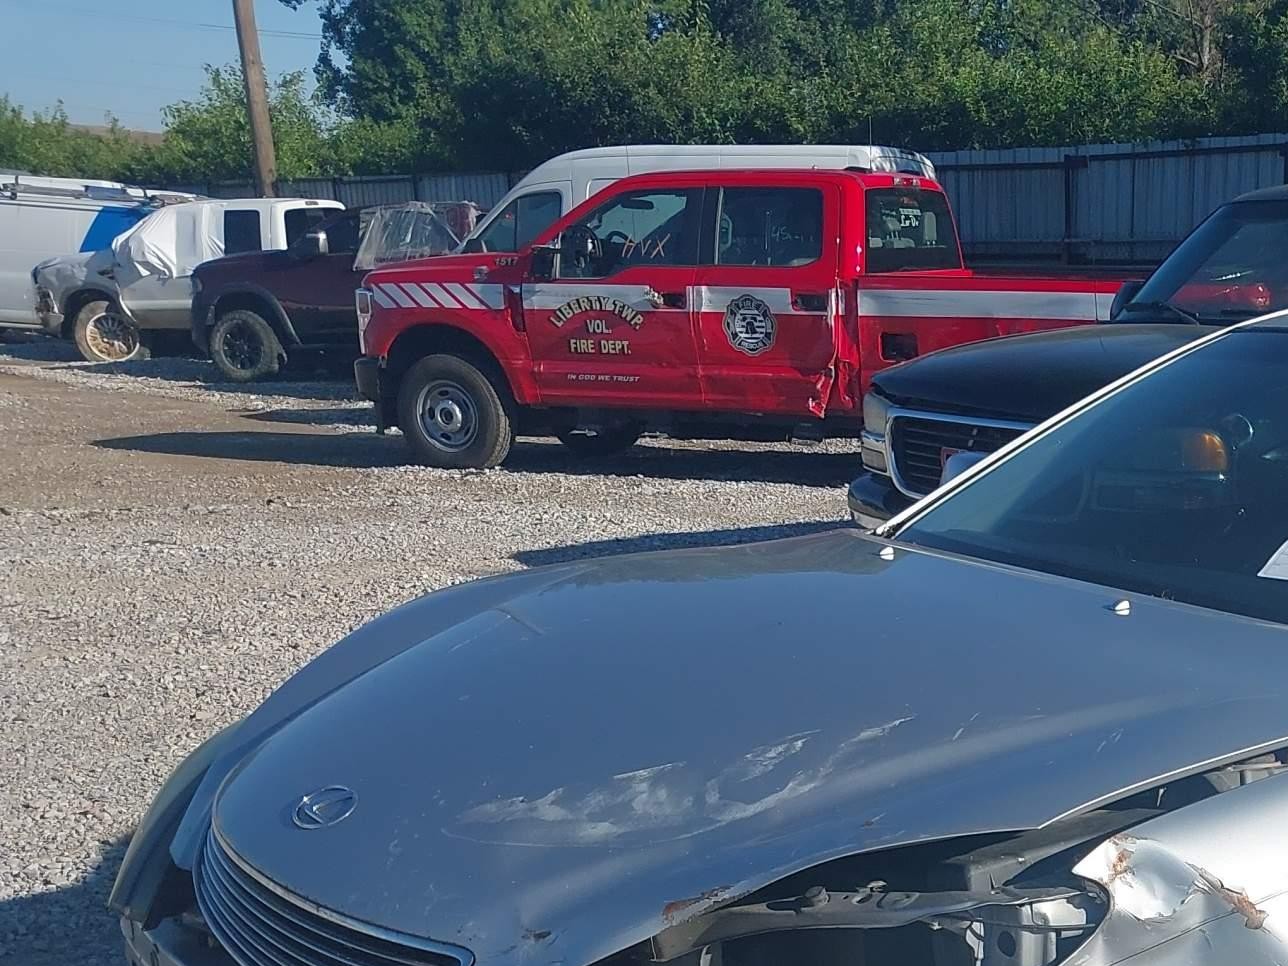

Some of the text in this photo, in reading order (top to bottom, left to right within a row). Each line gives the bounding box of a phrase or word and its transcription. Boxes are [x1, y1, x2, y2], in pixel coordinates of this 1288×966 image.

[495, 256, 519, 266] 1517
[549, 295, 645, 330] LIBERTY TWP.
[586, 319, 613, 334] VOL.
[569, 339, 632, 355] FIRE DEPT.
[567, 373, 577, 381] IN
